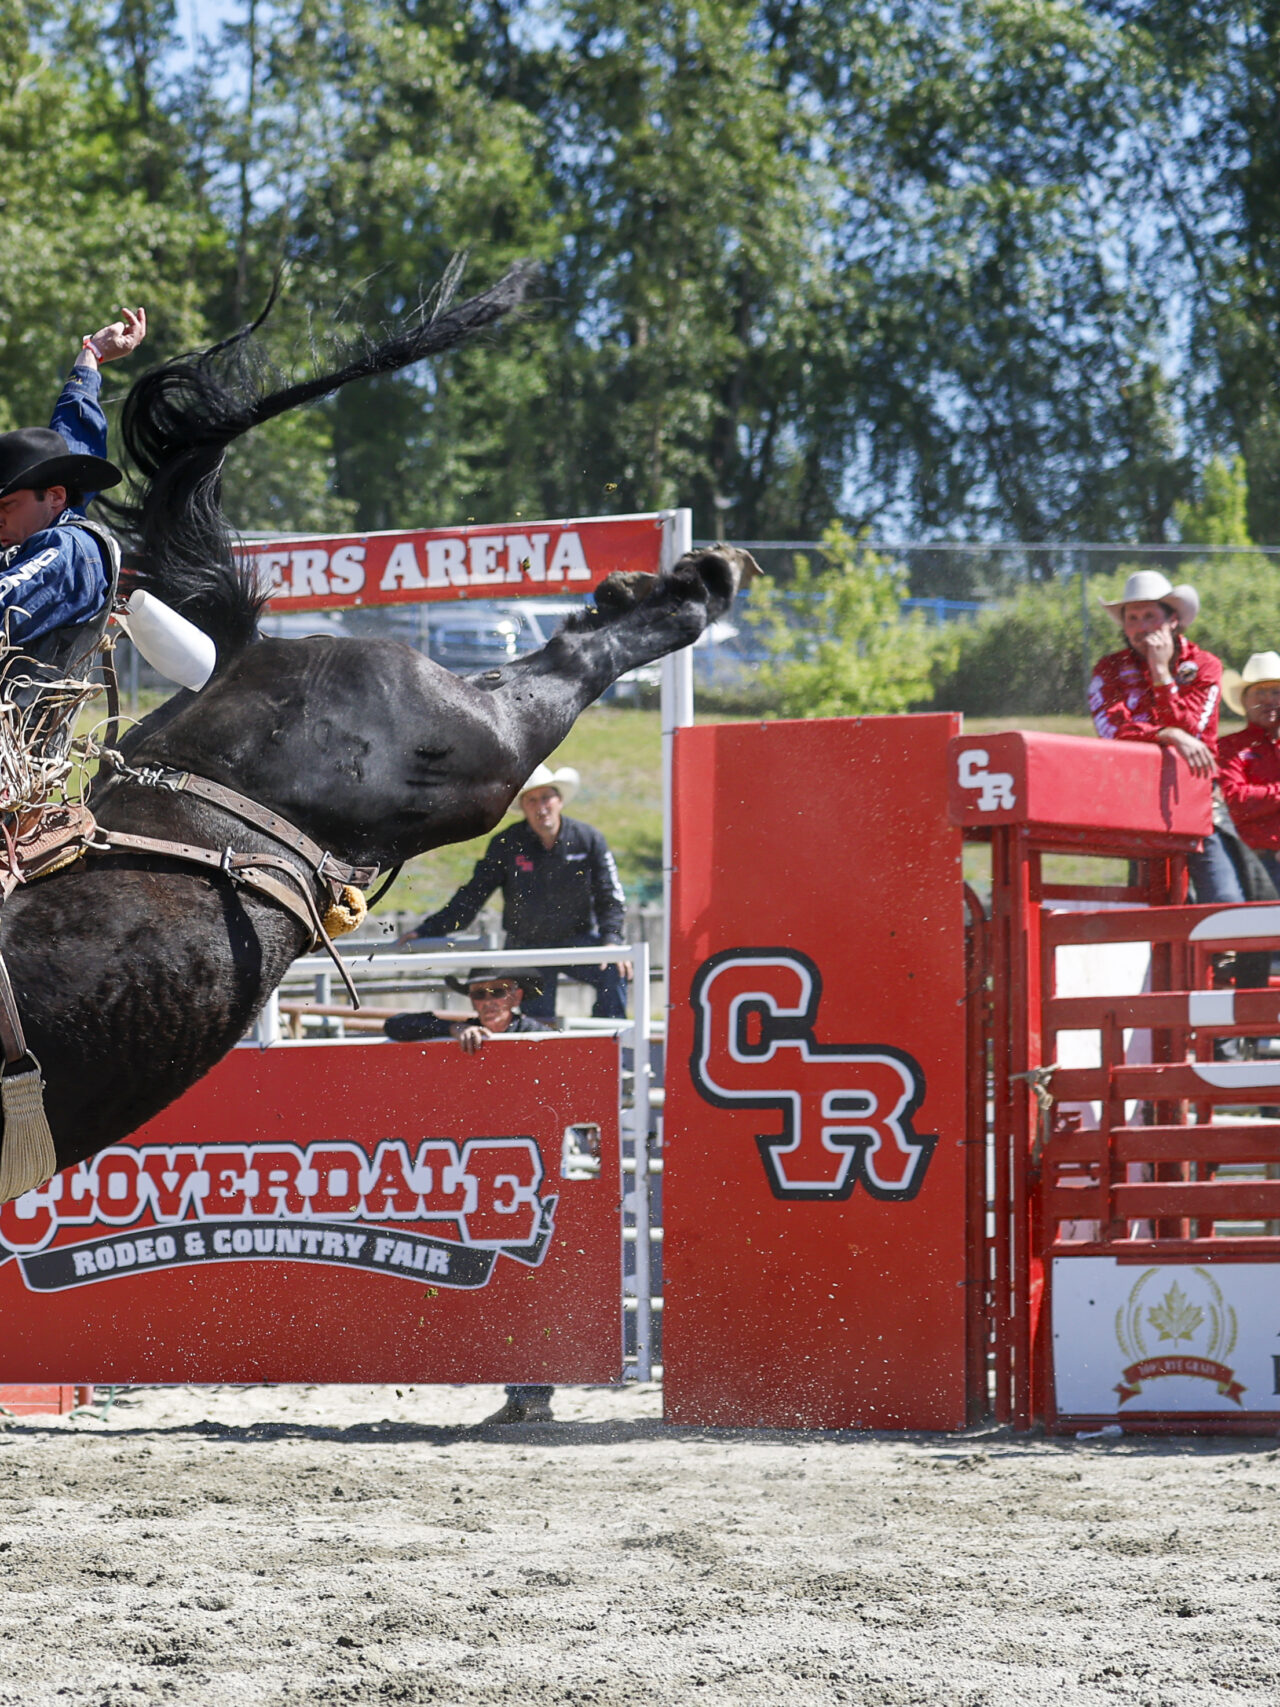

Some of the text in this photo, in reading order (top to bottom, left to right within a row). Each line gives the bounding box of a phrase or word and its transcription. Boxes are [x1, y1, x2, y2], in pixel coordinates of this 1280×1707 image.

[380, 532, 592, 591] ARENA
[957, 749, 1017, 812] CR
[690, 947, 938, 1200] CR
[73, 1228, 452, 1277] RODEO & COUNTRY FAIR
